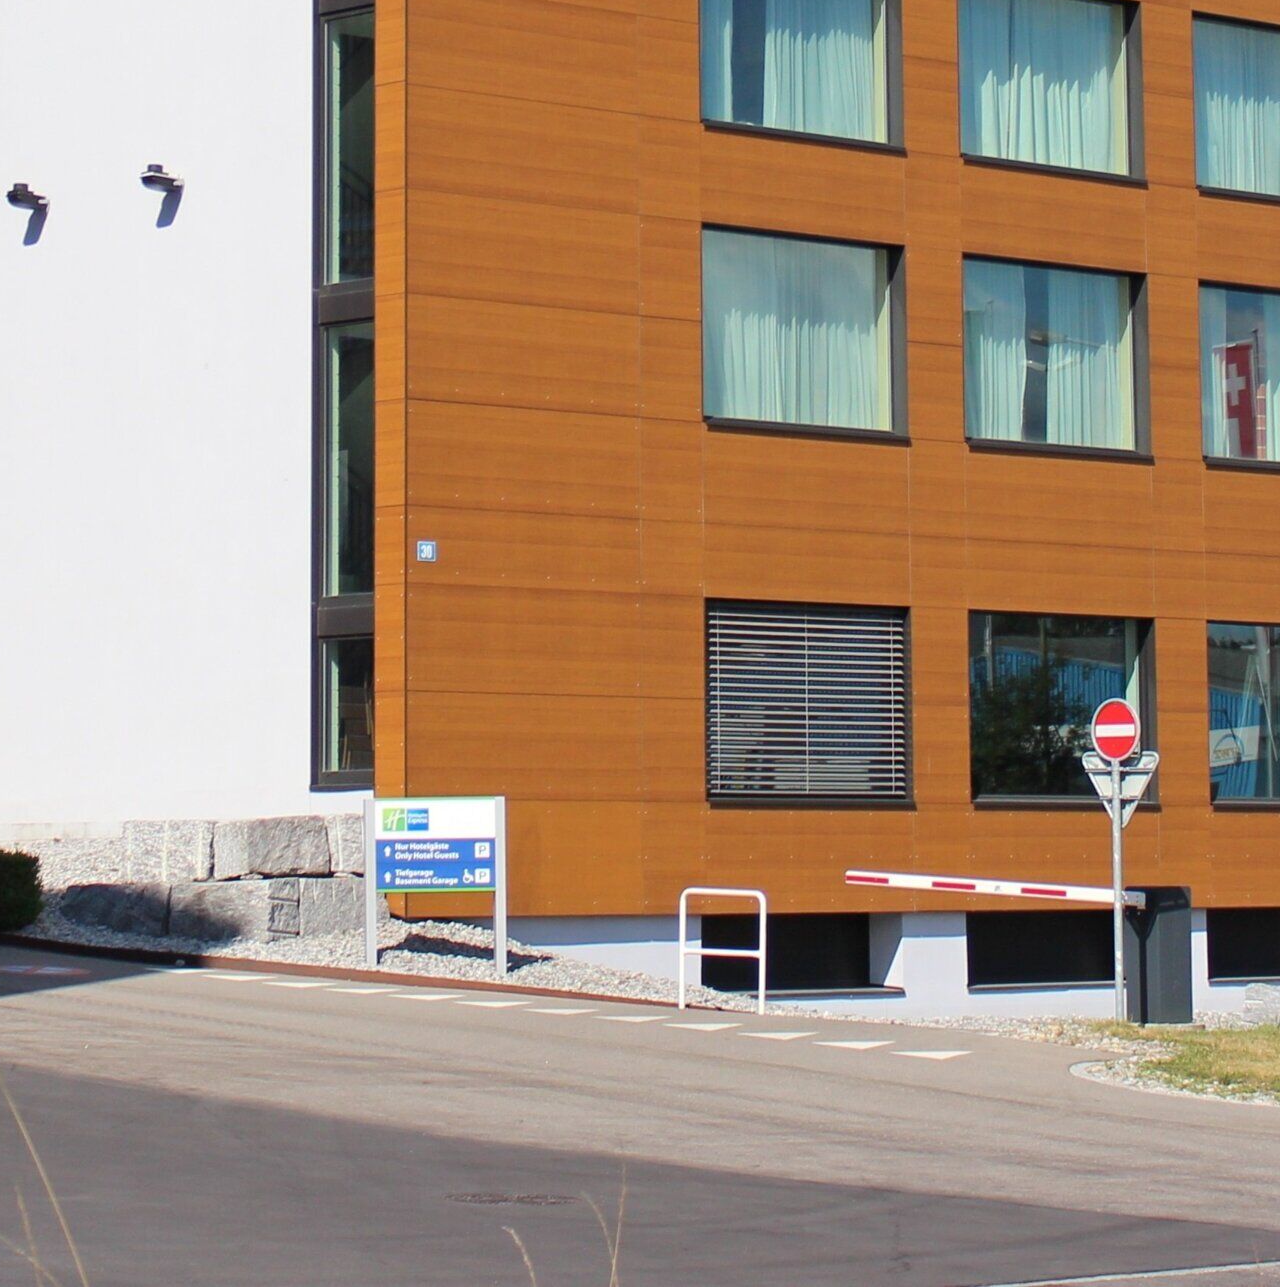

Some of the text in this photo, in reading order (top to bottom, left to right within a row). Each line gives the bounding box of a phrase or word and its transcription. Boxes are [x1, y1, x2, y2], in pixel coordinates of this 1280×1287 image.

[421, 545, 432, 558] 30
[395, 842, 449, 852] Nur Hotelgäste
[395, 851, 459, 861] Only Hotel Guests
[395, 869, 434, 878] Tiefgarage
[395, 877, 459, 886] Basement Garage
